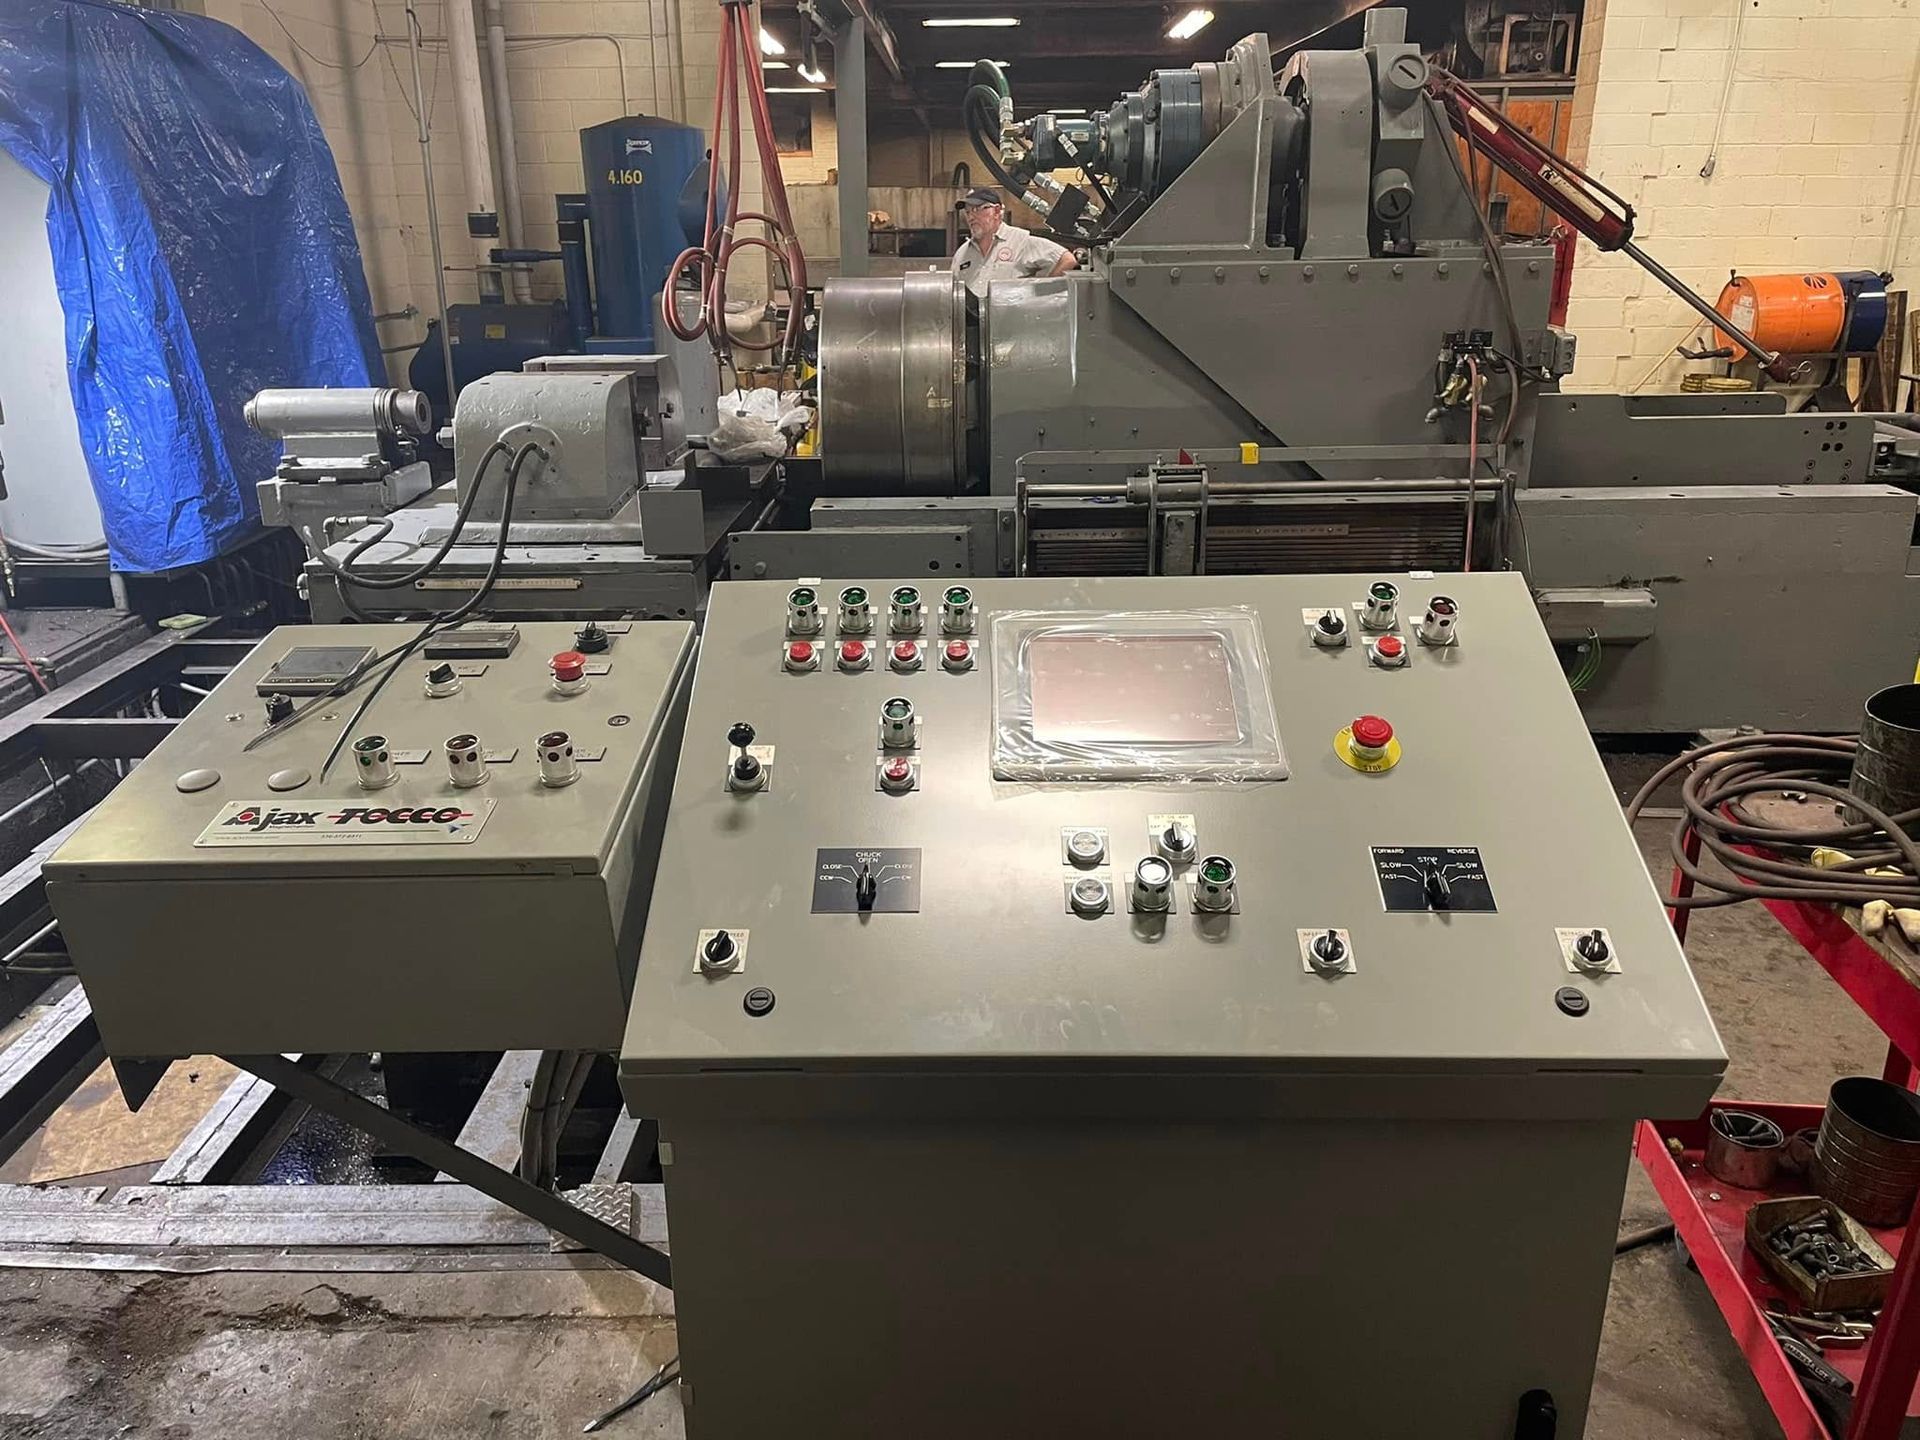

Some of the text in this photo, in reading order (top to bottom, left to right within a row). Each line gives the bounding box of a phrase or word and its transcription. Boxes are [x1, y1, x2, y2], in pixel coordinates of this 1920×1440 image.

[608, 169, 643, 185] 4.160
[221, 806, 462, 832] Ajax TOCCO
[1380, 861, 1402, 869] SLOW
[1455, 861, 1478, 869] SLOW
